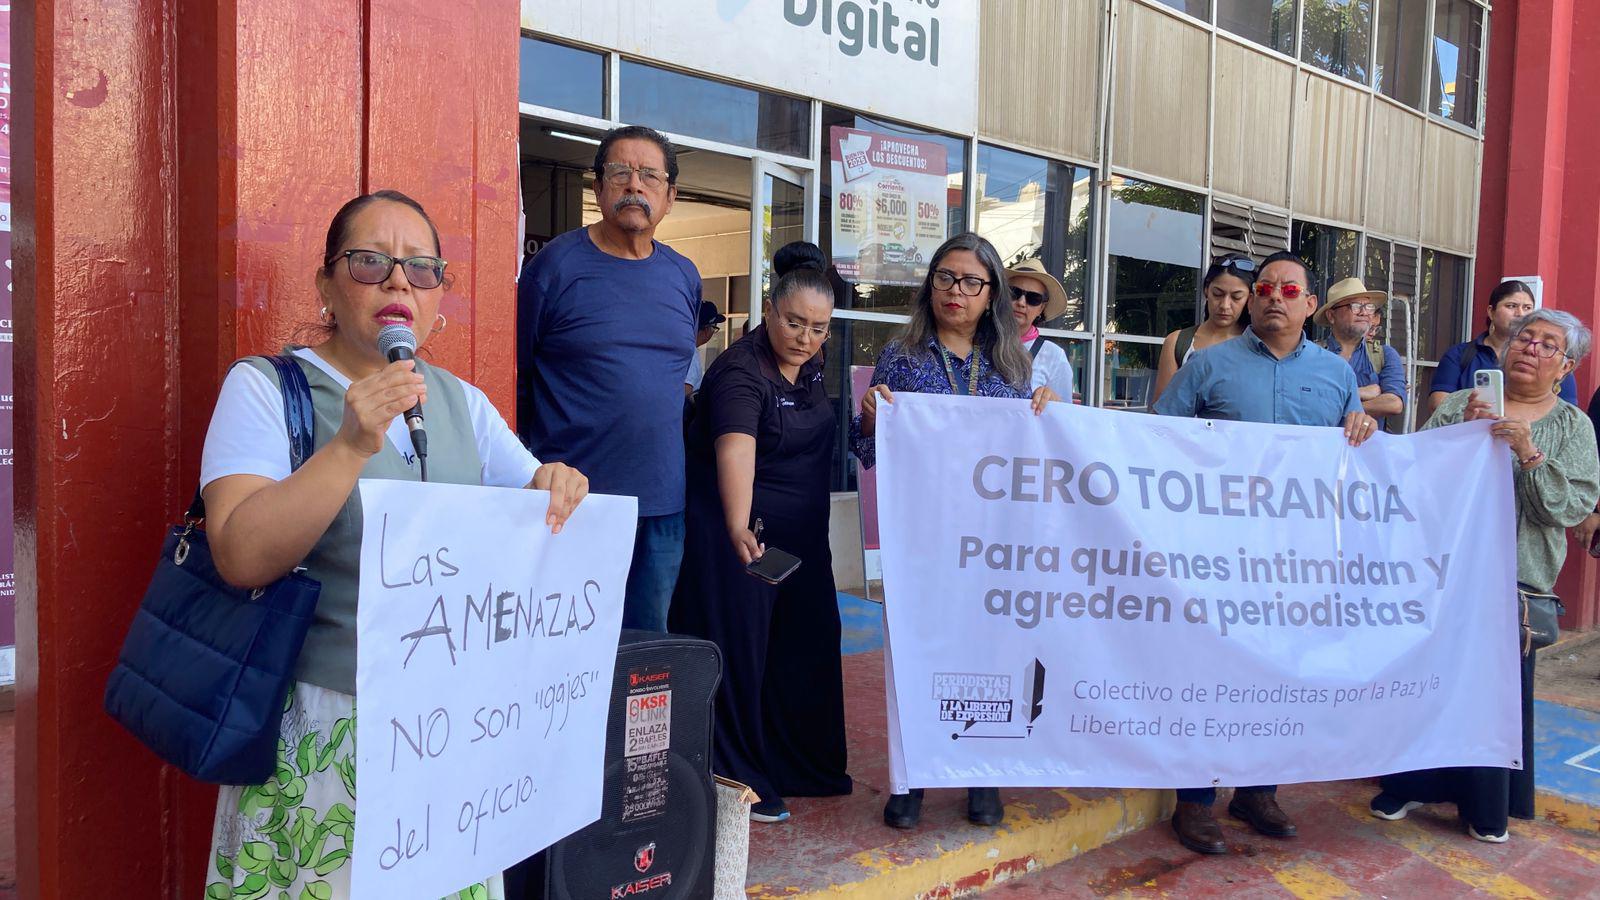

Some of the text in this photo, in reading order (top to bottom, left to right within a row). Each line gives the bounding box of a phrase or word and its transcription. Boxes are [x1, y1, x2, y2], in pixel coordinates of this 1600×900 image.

[784, 0, 939, 67] Digital
[880, 140, 919, 156] ¡APROVECHA
[873, 151, 884, 163] LOS
[886, 153, 927, 170] DESCUENTOS!
[876, 197, 907, 216] $6,000
[917, 201, 939, 218] 50%
[972, 455, 1417, 523] CERO TOLERANCIA
[381, 513, 459, 588] Las
[959, 536, 1060, 573] Para
[1071, 540, 1231, 586] quienes
[1238, 547, 1417, 585] intimidan
[984, 586, 1425, 636] agreden a periodistas
[400, 579, 600, 669] AMENAZAS
[639, 672, 669, 683] KAISER
[934, 674, 1010, 688] PERIODISTAS
[933, 686, 1009, 701] POR LA PAZ
[1073, 673, 1440, 707] Colectivo de Periodistas por la Paz y la
[640, 694, 667, 711] KSR
[941, 701, 1011, 712] Y LA LIBERTAD
[941, 711, 954, 721] DE
[390, 707, 450, 772] NO
[470, 702, 521, 743] son
[628, 723, 667, 738] ENLAZA
[1070, 714, 1304, 742] Libertad de Expresión
[628, 738, 638, 752] 2
[638, 733, 667, 744] BAFLES
[379, 802, 430, 870] del
[611, 872, 672, 900] KAISER
